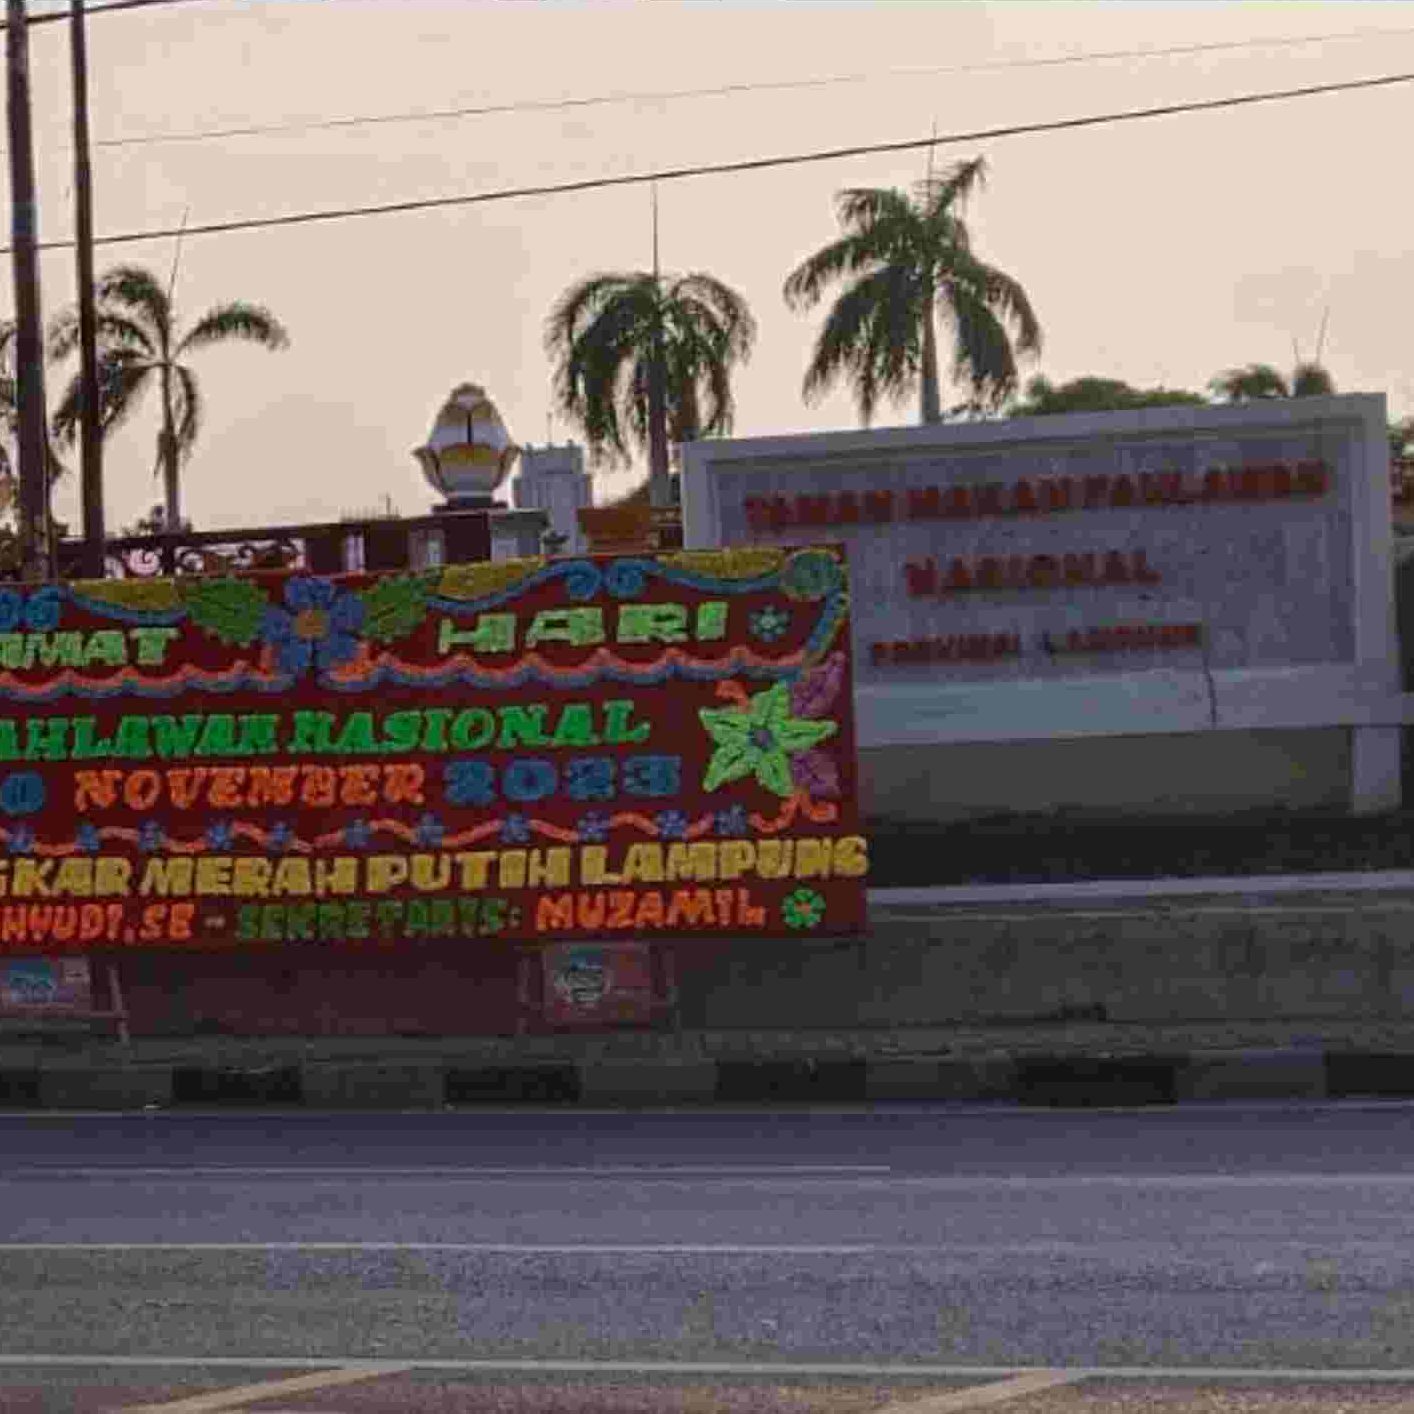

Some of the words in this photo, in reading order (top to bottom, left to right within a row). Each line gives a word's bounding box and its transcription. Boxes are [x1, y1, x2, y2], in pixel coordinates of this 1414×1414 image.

[905, 551, 1163, 597] NASIONAL
[438, 601, 728, 654] HARI
[289, 703, 650, 754] NASIONAL
[74, 763, 425, 813] NOVEMBER
[443, 754, 682, 806] 2023
[138, 853, 357, 897] MERAH
[365, 847, 570, 893] PUTIH
[581, 836, 869, 883] LAMPUNG
[536, 888, 766, 932] MUZAMIL
